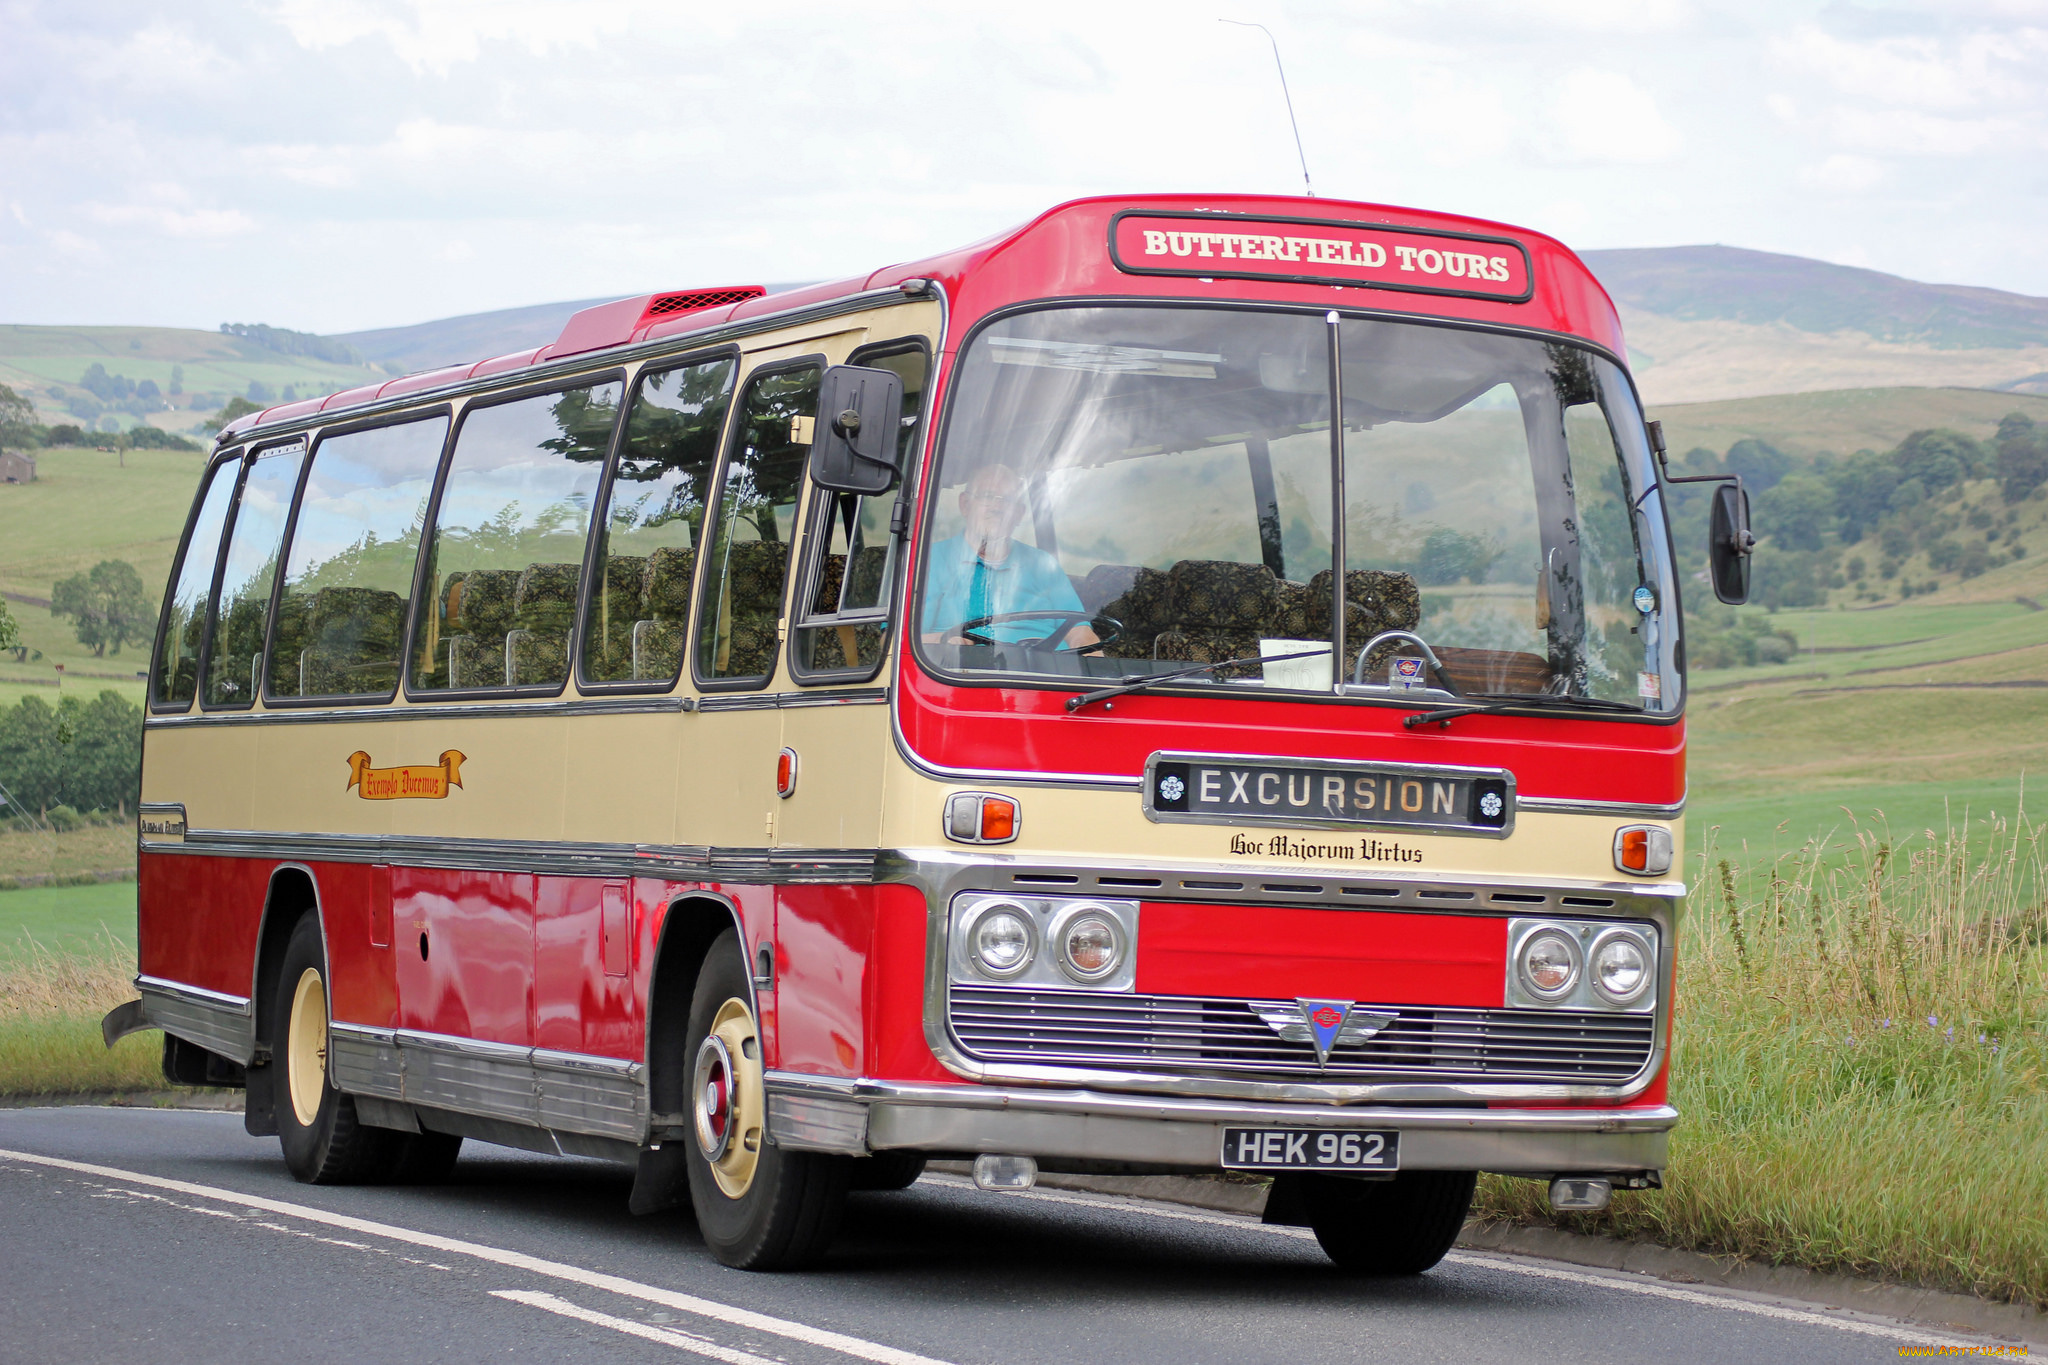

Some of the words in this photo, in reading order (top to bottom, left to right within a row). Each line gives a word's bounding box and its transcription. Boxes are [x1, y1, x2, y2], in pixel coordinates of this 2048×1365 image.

[1143, 230, 1387, 268] BUTTERFIELD
[1396, 246, 1511, 282] TOURS
[1200, 769, 1456, 815] EXCURSION
[1268, 835, 1354, 863] Majorum
[1359, 838, 1423, 863] Virtus
[1316, 1013, 1339, 1023] AEC
[1238, 1132, 1309, 1164] HEK
[1316, 1133, 1385, 1165] 962
